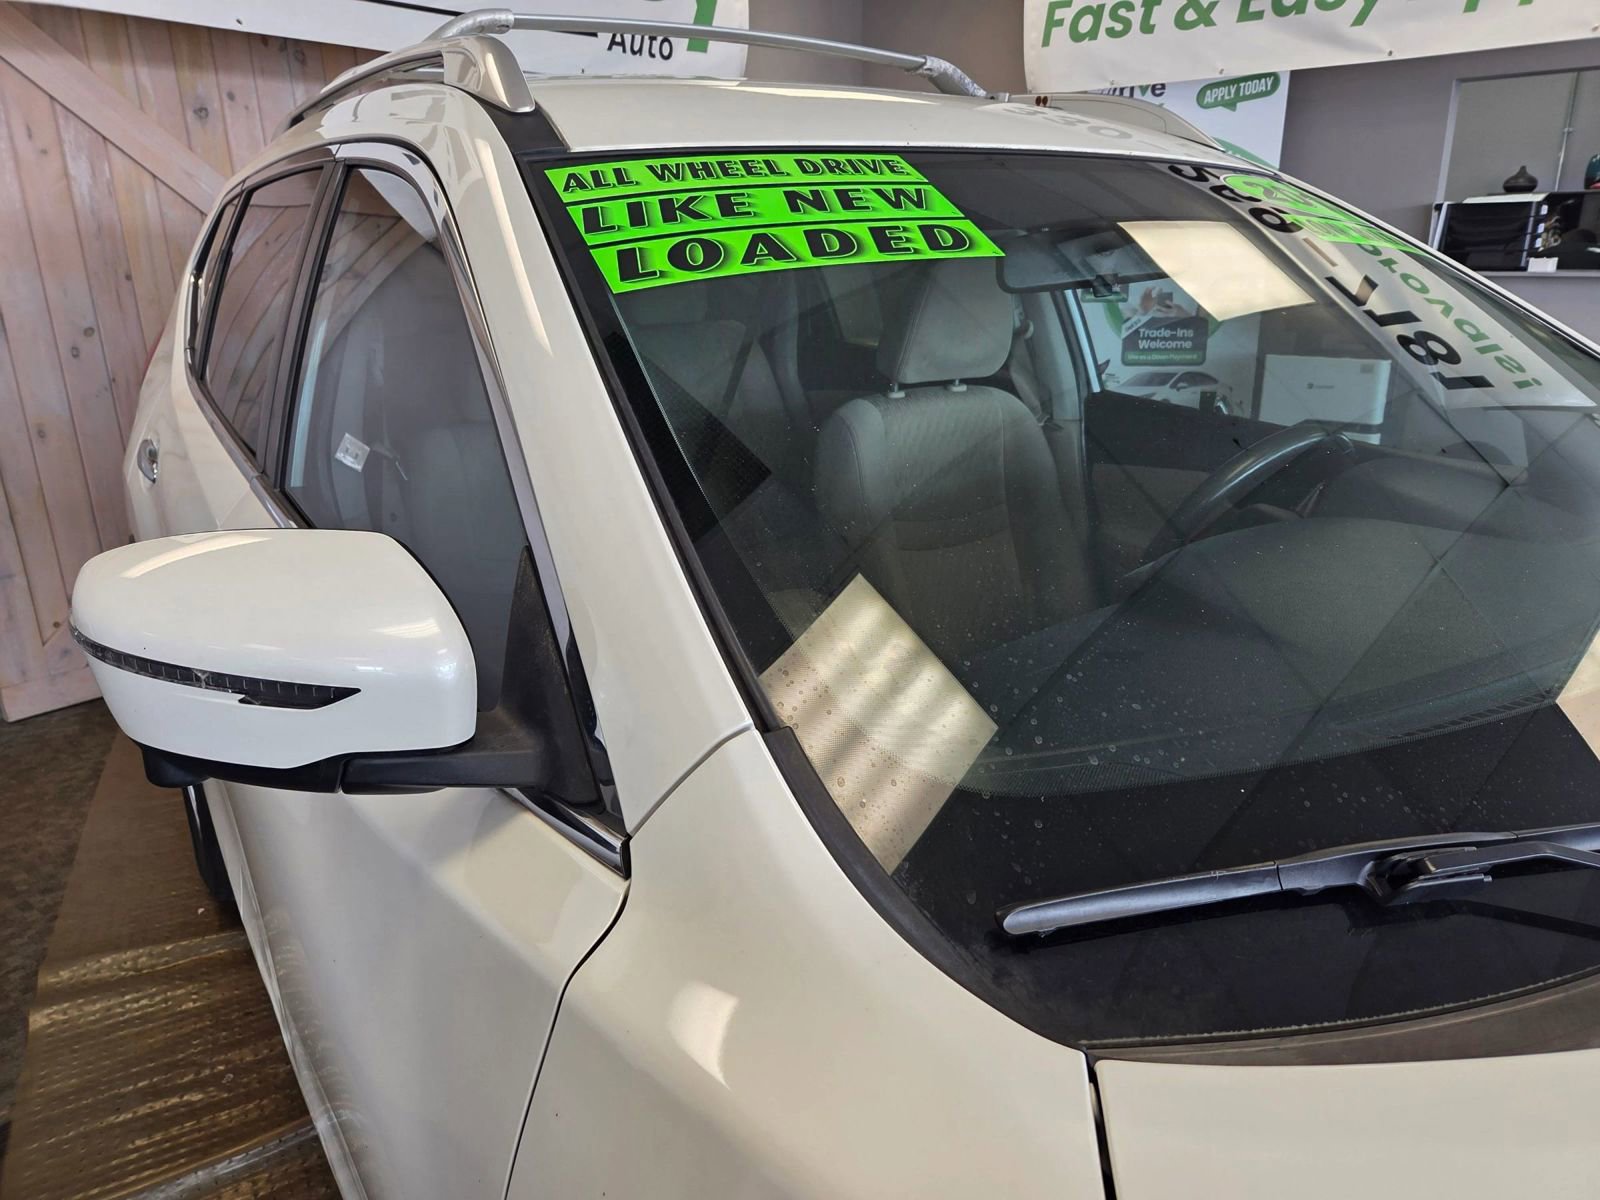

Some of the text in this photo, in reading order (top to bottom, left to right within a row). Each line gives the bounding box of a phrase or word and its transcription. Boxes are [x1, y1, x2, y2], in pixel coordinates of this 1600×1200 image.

[1041, 0, 1162, 48] Fast
[1173, 0, 1219, 31] &
[607, 32, 673, 61] Auto
[1203, 76, 1275, 105] APPLY TODAY
[561, 156, 909, 193] ALL WHEEL DRIVE
[581, 188, 930, 235] LIKE NEW
[615, 224, 970, 282] LOADED
[1138, 327, 1194, 338] Trade-Ins
[1138, 339, 1193, 350] Welcome
